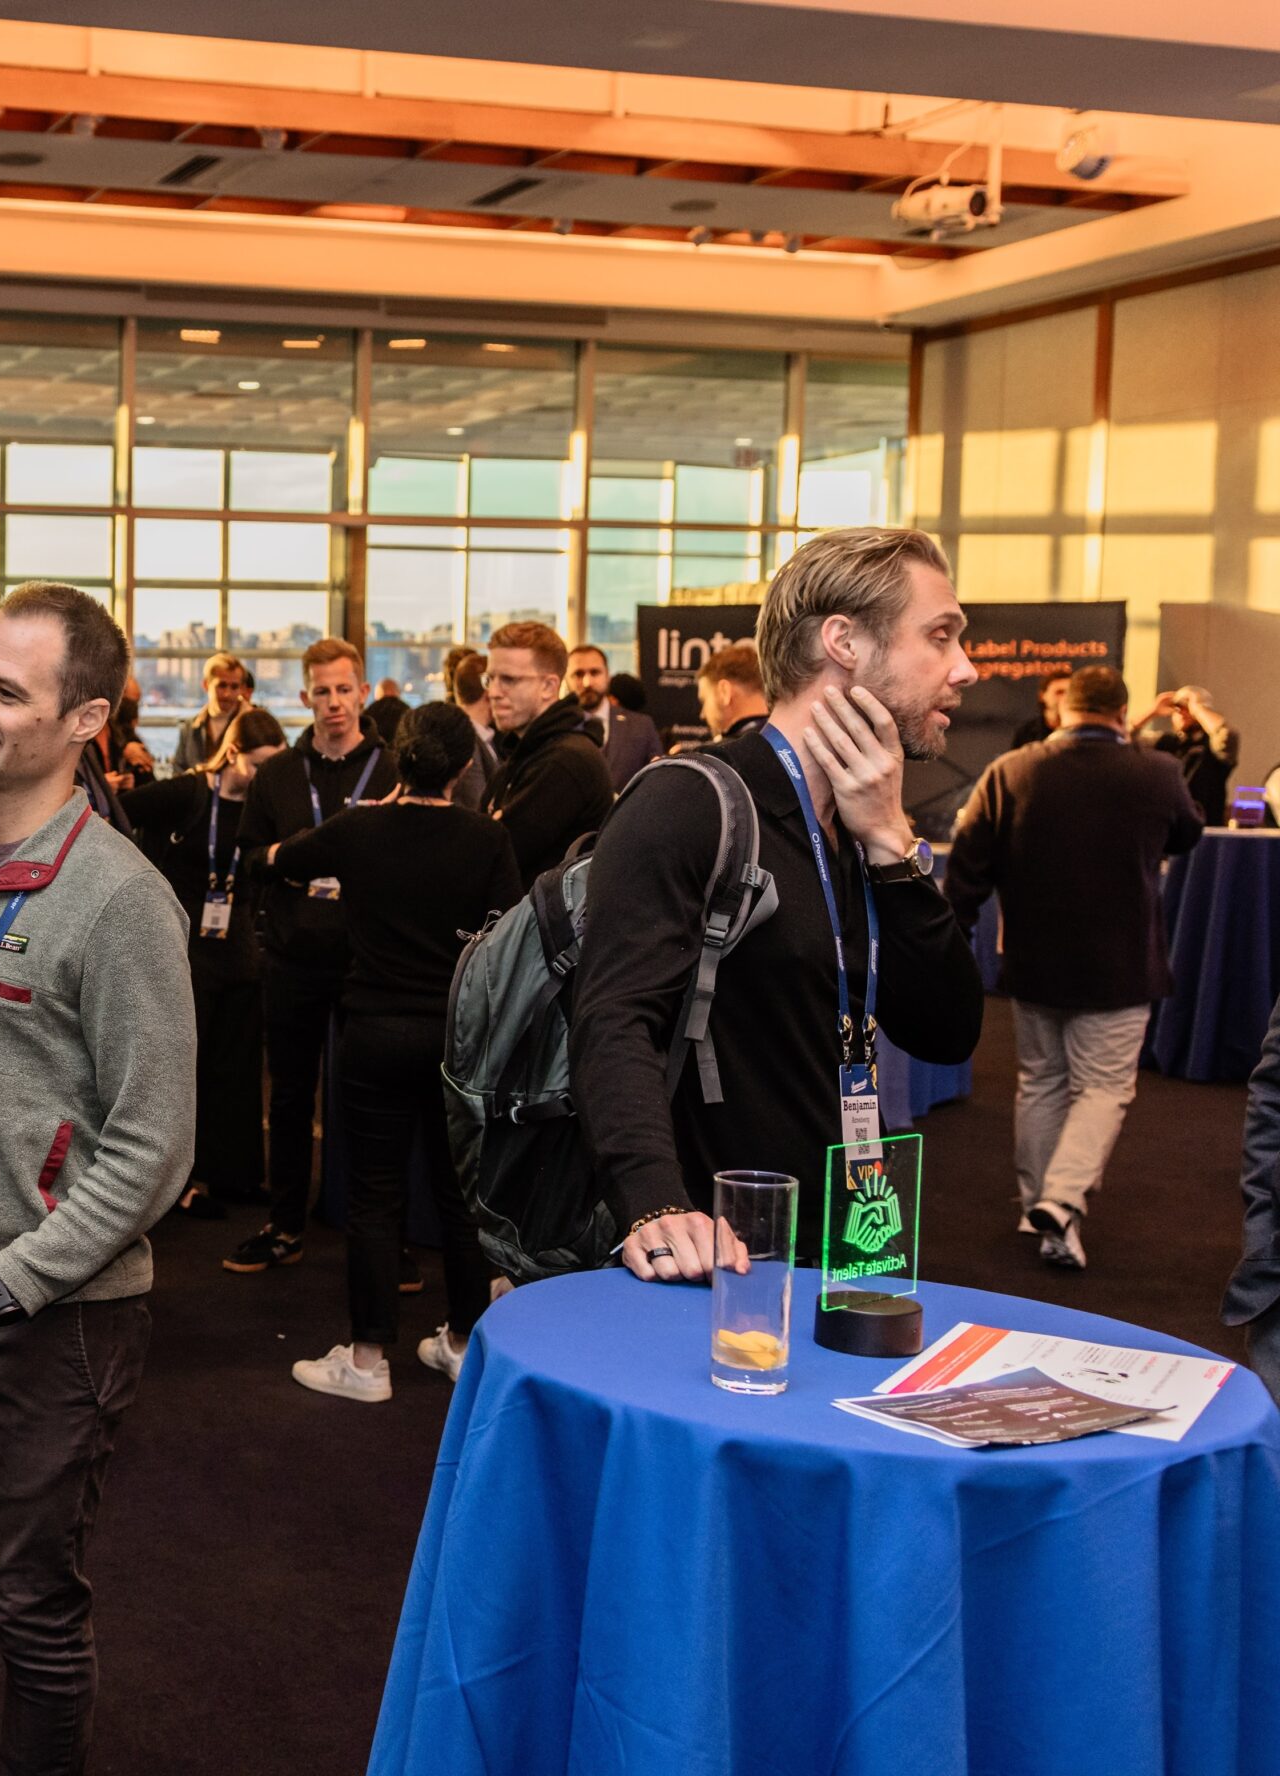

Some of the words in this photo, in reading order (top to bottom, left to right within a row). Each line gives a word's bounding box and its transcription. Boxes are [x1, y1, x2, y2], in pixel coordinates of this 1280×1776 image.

[657, 628, 756, 670] lint
[964, 638, 1017, 659] Label
[1021, 638, 1108, 659] Products
[813, 843, 828, 882] Payoneer
[842, 1099, 877, 1114] Benjamin
[857, 1164, 875, 1180] VIP
